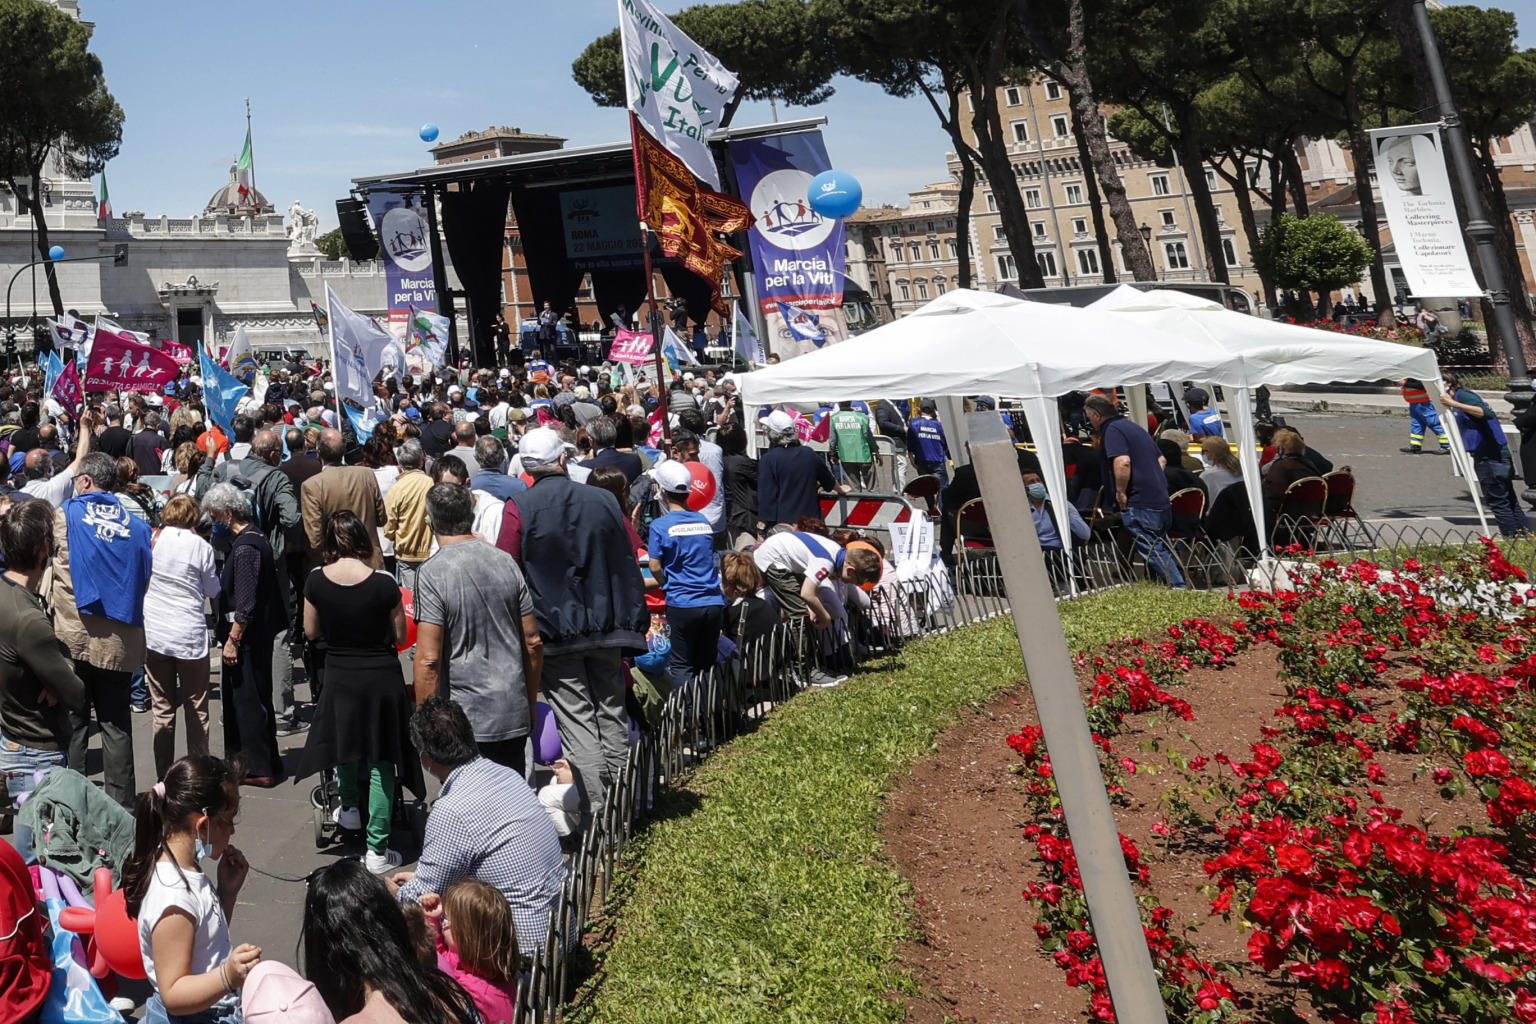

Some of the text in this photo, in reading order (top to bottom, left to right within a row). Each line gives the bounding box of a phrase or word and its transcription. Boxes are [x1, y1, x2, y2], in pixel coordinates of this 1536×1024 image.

[774, 257, 827, 273] Marcia
[401, 277, 434, 290] Marcia
[765, 275, 790, 292] per
[792, 272, 805, 286] la
[395, 292, 412, 304] per
[413, 291, 423, 302] la
